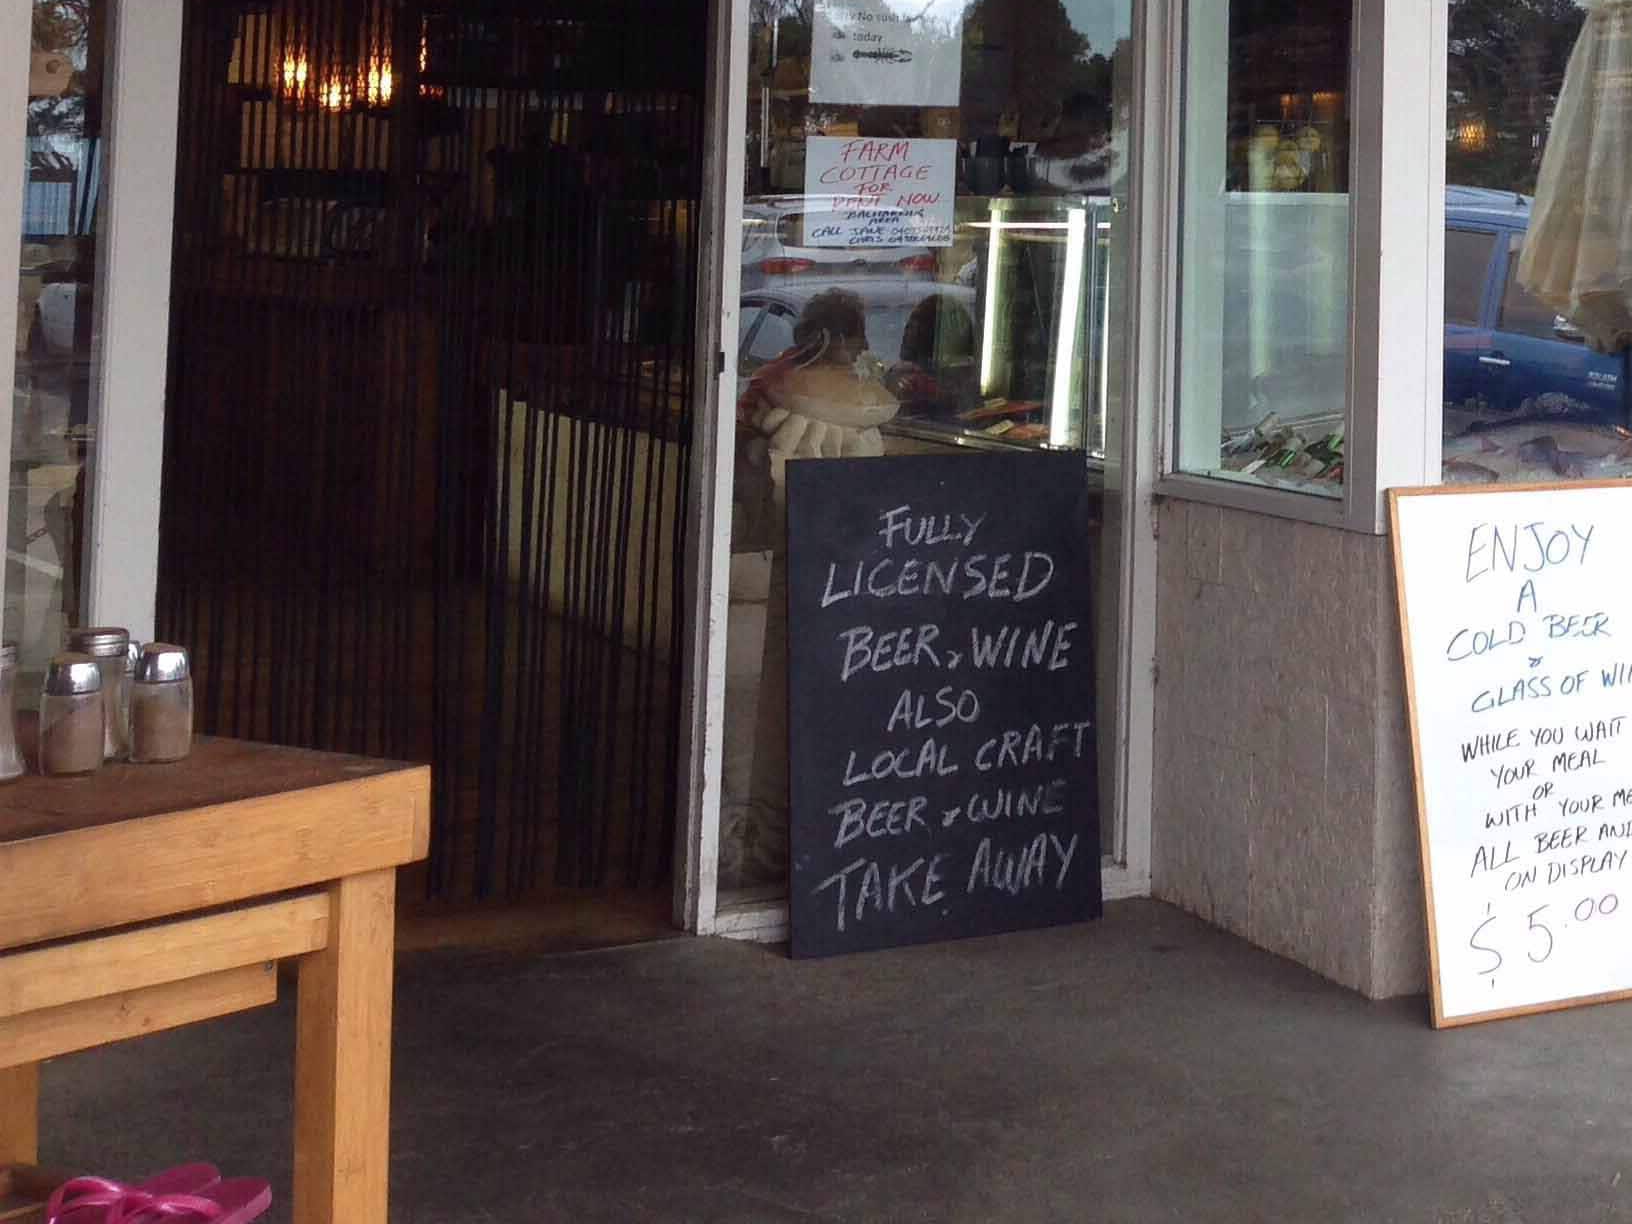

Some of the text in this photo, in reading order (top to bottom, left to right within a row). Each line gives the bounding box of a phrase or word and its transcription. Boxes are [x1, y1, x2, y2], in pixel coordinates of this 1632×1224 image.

[840, 139, 911, 163] FARM
[819, 164, 931, 184] COTTAGE
[855, 183, 893, 194] FOR
[896, 193, 940, 207] NOW
[811, 226, 842, 238] CALL
[879, 506, 985, 548] FULLY
[1465, 522, 1594, 583] ENJOY
[821, 552, 1054, 607] LICENSED
[1516, 579, 1537, 613] A
[838, 624, 941, 683] BEER
[970, 620, 1078, 671] WINE
[1446, 612, 1612, 661] COLD BEER
[887, 685, 981, 731] ALSO
[1471, 676, 1552, 712] GLASS
[1560, 670, 1589, 695] OF
[843, 721, 1090, 786] LOCAL CRAFT
[1460, 728, 1520, 763] WHILE
[1529, 727, 1564, 746] YOU
[1575, 716, 1627, 742] WAIT
[1490, 748, 1607, 789] YOUR MEAL
[1484, 803, 1537, 829] WITH
[1558, 794, 1604, 817] YOUR
[1532, 781, 1554, 801] OR
[828, 796, 928, 850] BEER
[967, 779, 1066, 823] WINE
[1470, 840, 1521, 879] ALL
[1534, 825, 1588, 854] BEER
[1504, 865, 1537, 892] ON
[1547, 849, 1628, 885] DISPLAY
[811, 832, 1079, 932] TAKE AWAY
